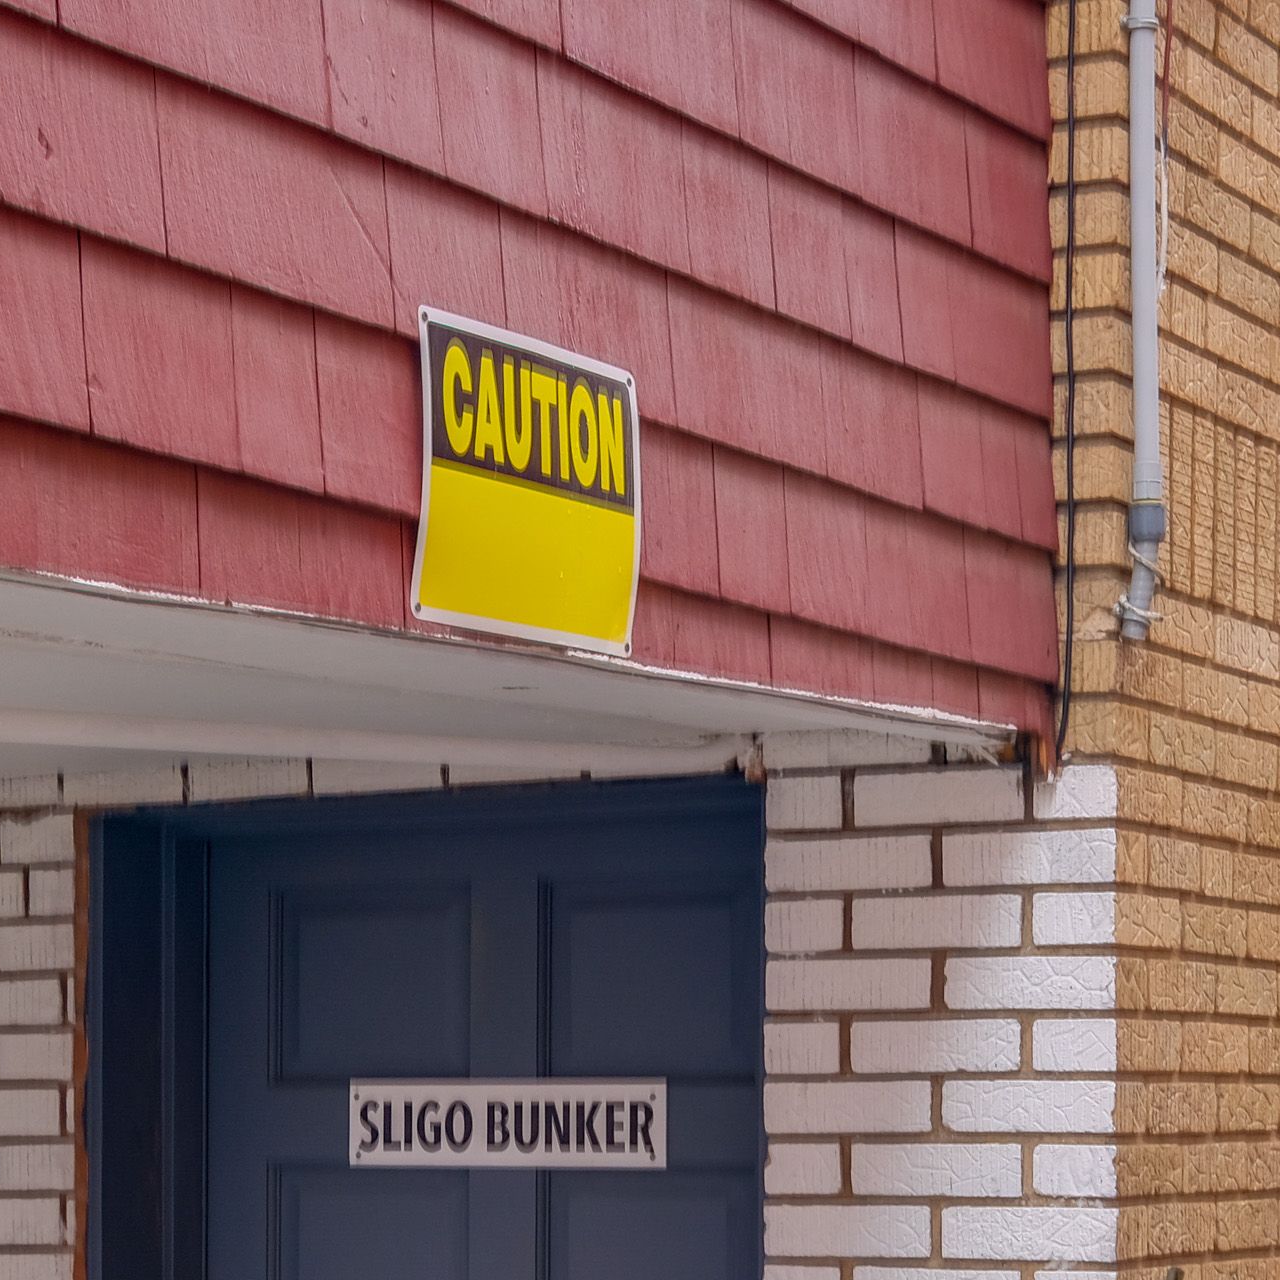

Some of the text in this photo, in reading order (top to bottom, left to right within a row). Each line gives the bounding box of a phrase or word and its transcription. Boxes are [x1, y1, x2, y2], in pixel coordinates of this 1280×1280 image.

[442, 339, 625, 496] CAUTION
[359, 1099, 656, 1154] SLIGO BUNKER
